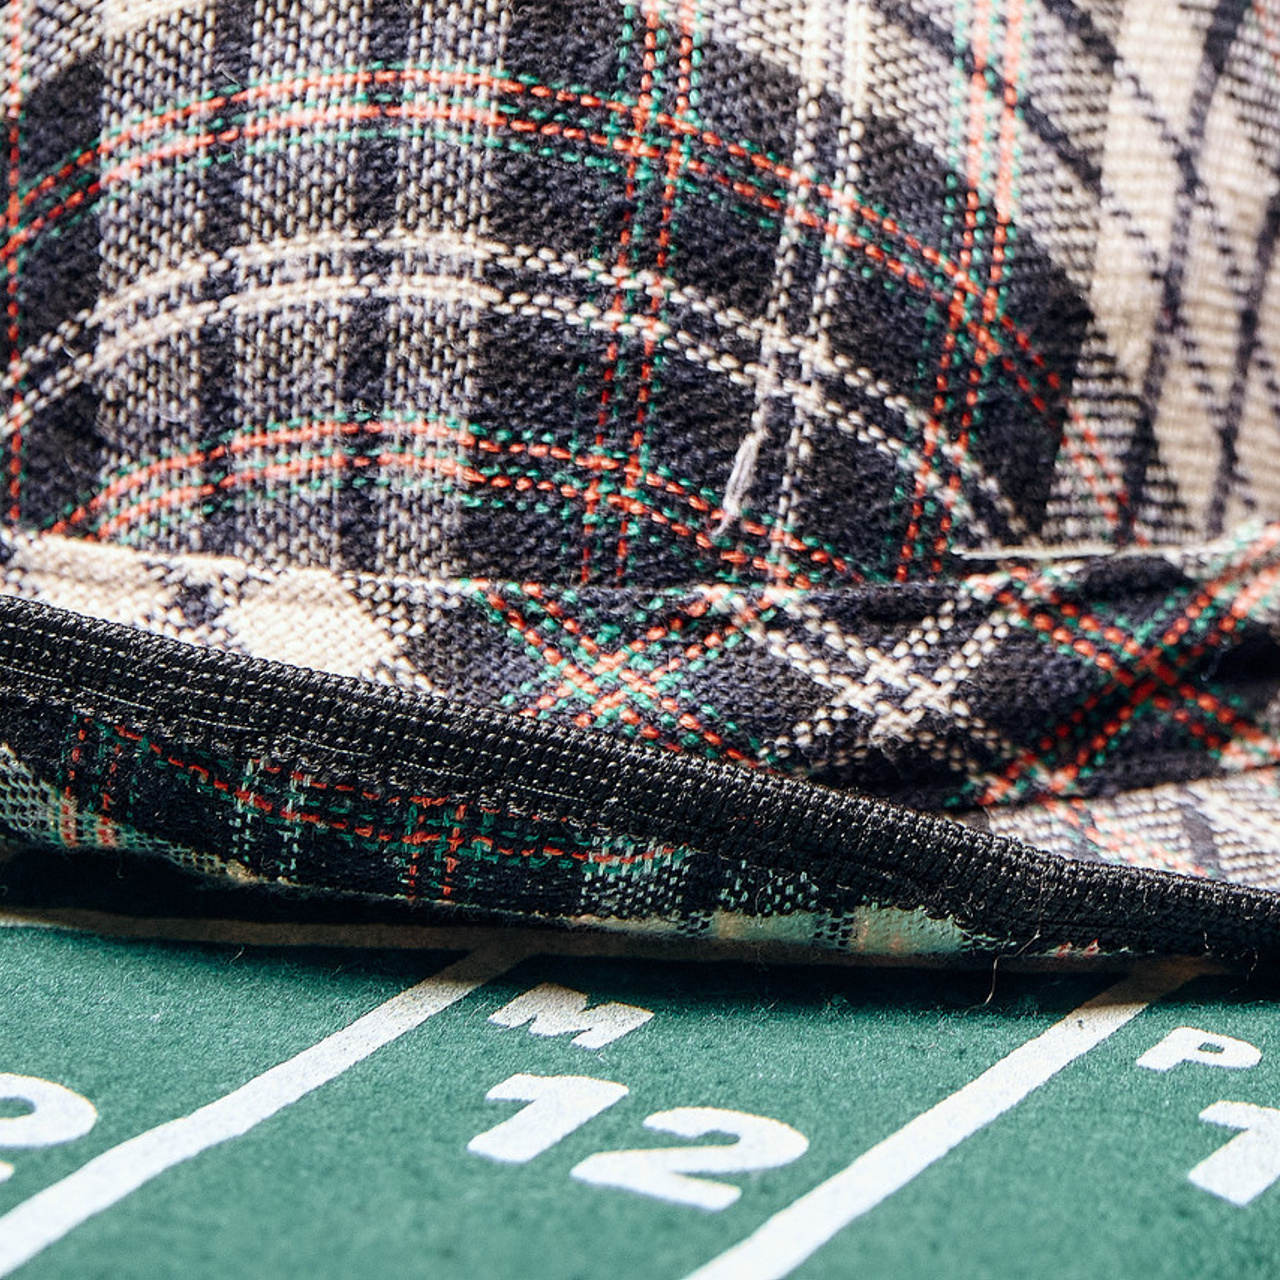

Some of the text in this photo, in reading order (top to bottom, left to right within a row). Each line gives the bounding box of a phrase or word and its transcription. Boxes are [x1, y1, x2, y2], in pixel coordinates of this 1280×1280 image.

[488, 982, 654, 1050] M
[1135, 1025, 1262, 1073] P
[467, 1071, 811, 1213] 12
